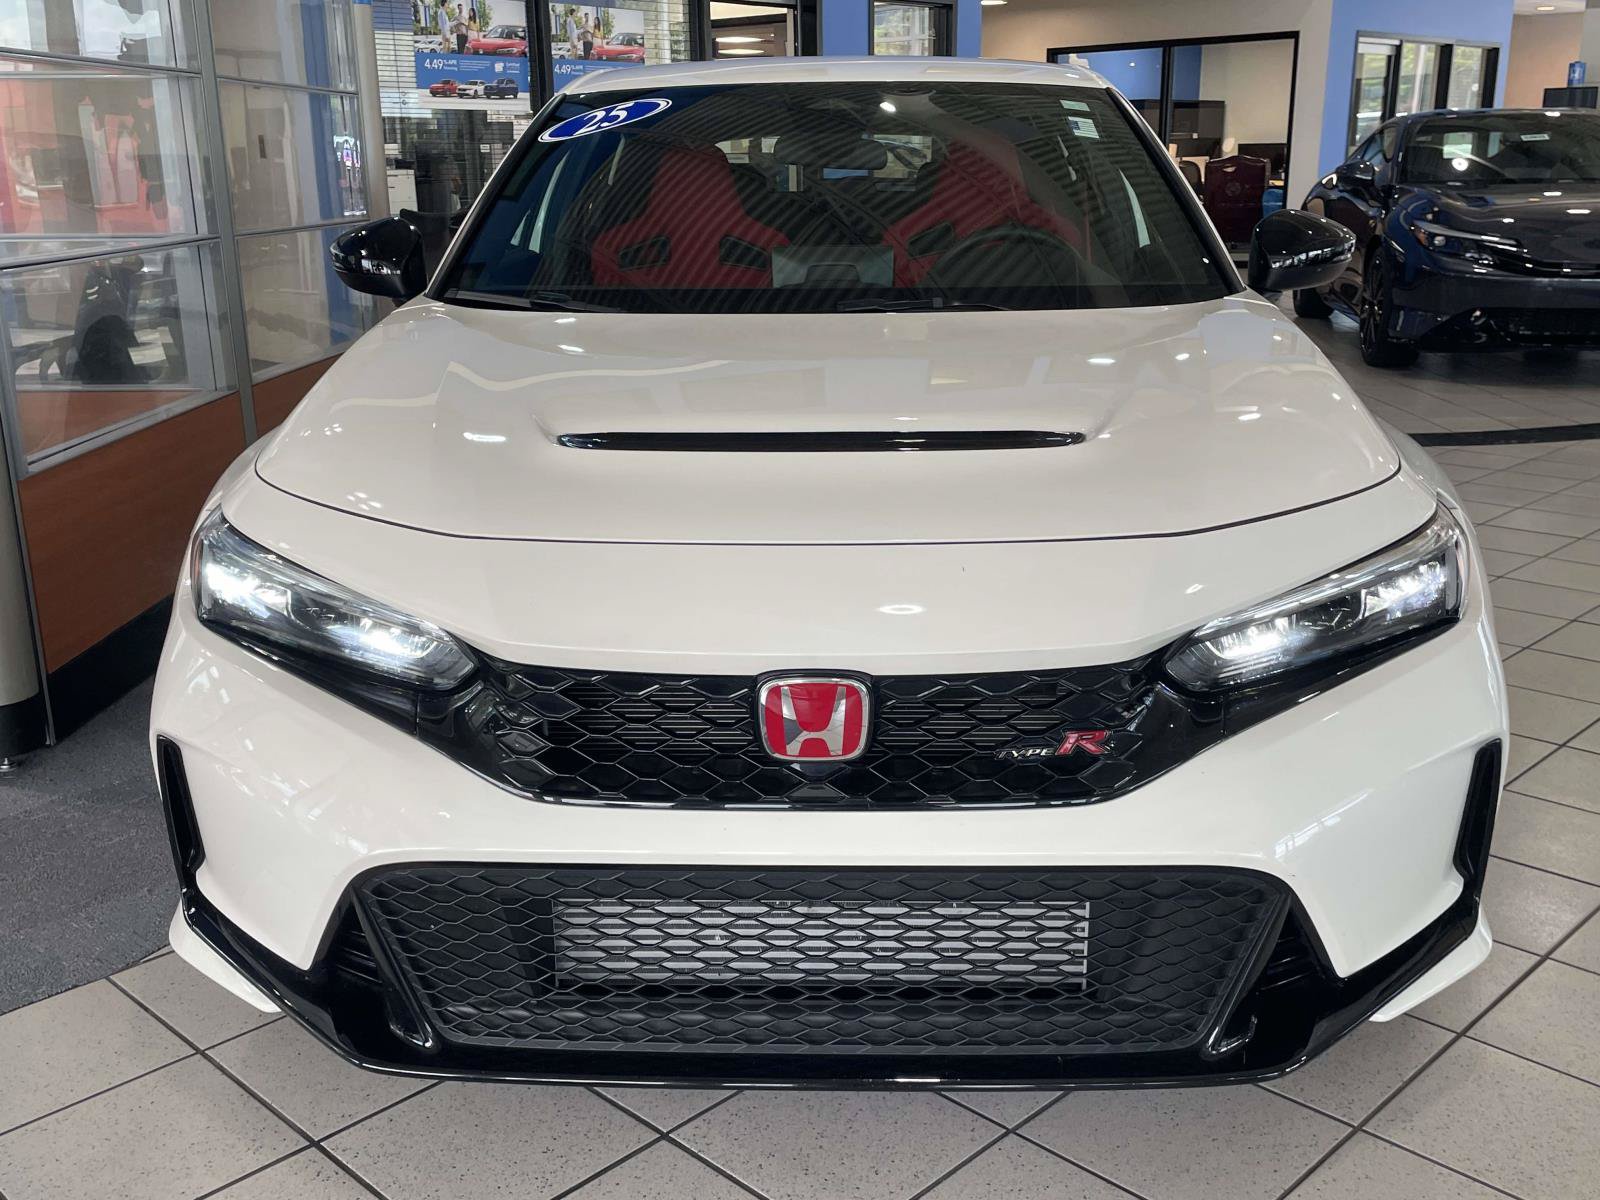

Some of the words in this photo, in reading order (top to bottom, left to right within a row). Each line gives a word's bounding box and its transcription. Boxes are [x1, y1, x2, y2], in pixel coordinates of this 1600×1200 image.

[424, 58, 444, 70] 4.49
[573, 101, 635, 135] 25
[993, 747, 1056, 760] TYPE
[1055, 730, 1110, 756] R
